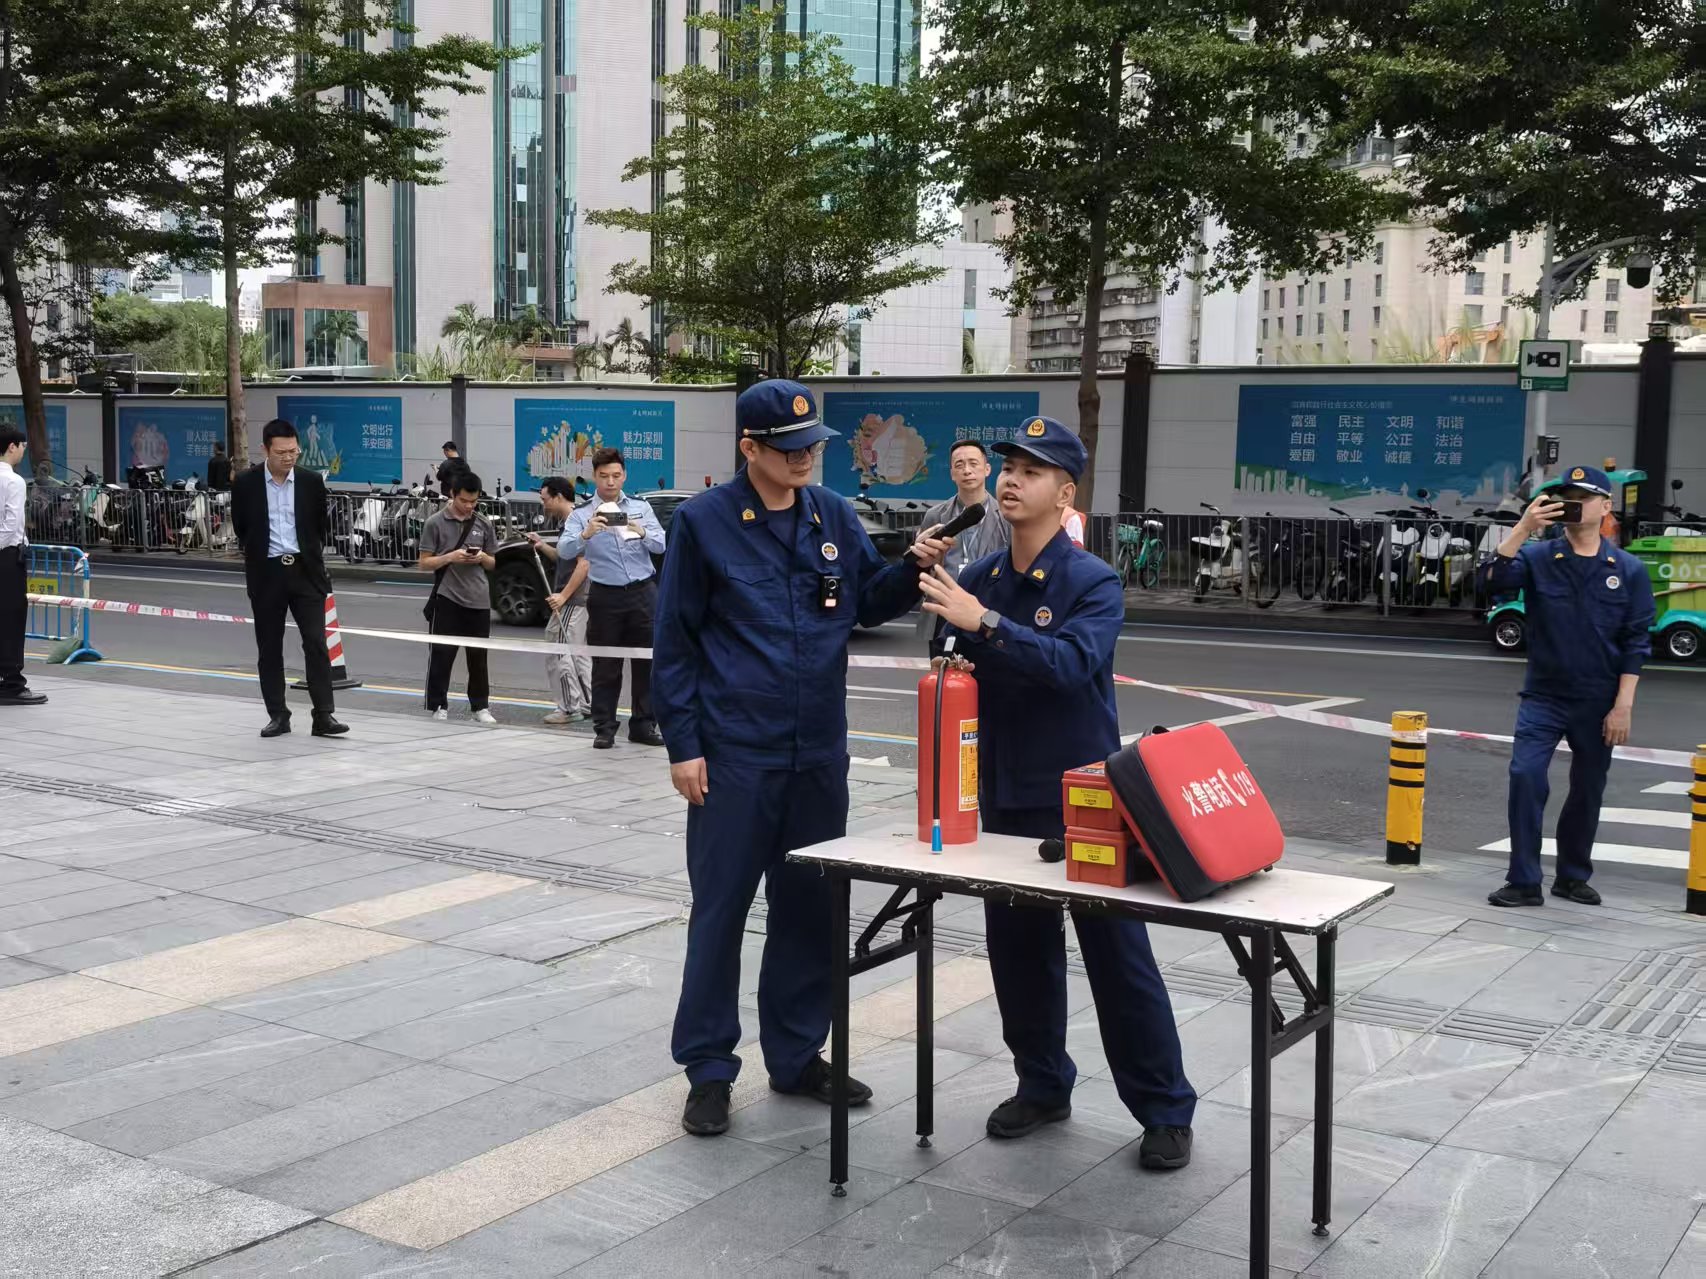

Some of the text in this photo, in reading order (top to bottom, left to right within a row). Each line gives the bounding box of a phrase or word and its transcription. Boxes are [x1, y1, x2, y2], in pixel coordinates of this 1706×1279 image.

[1291, 414, 1465, 430] 富强 民主 文明 和谐
[361, 424, 393, 436] 文明出行
[361, 437, 393, 449] 平安回家
[623, 431, 663, 445] 魅力深圳
[1290, 432, 1463, 447] 自由 平等 公正 法治
[623, 446, 663, 460] 美丽家园
[1289, 449, 1463, 465] 爱国 敬业 诚信 友善
[1181, 770, 1256, 817] 火警电话 119
